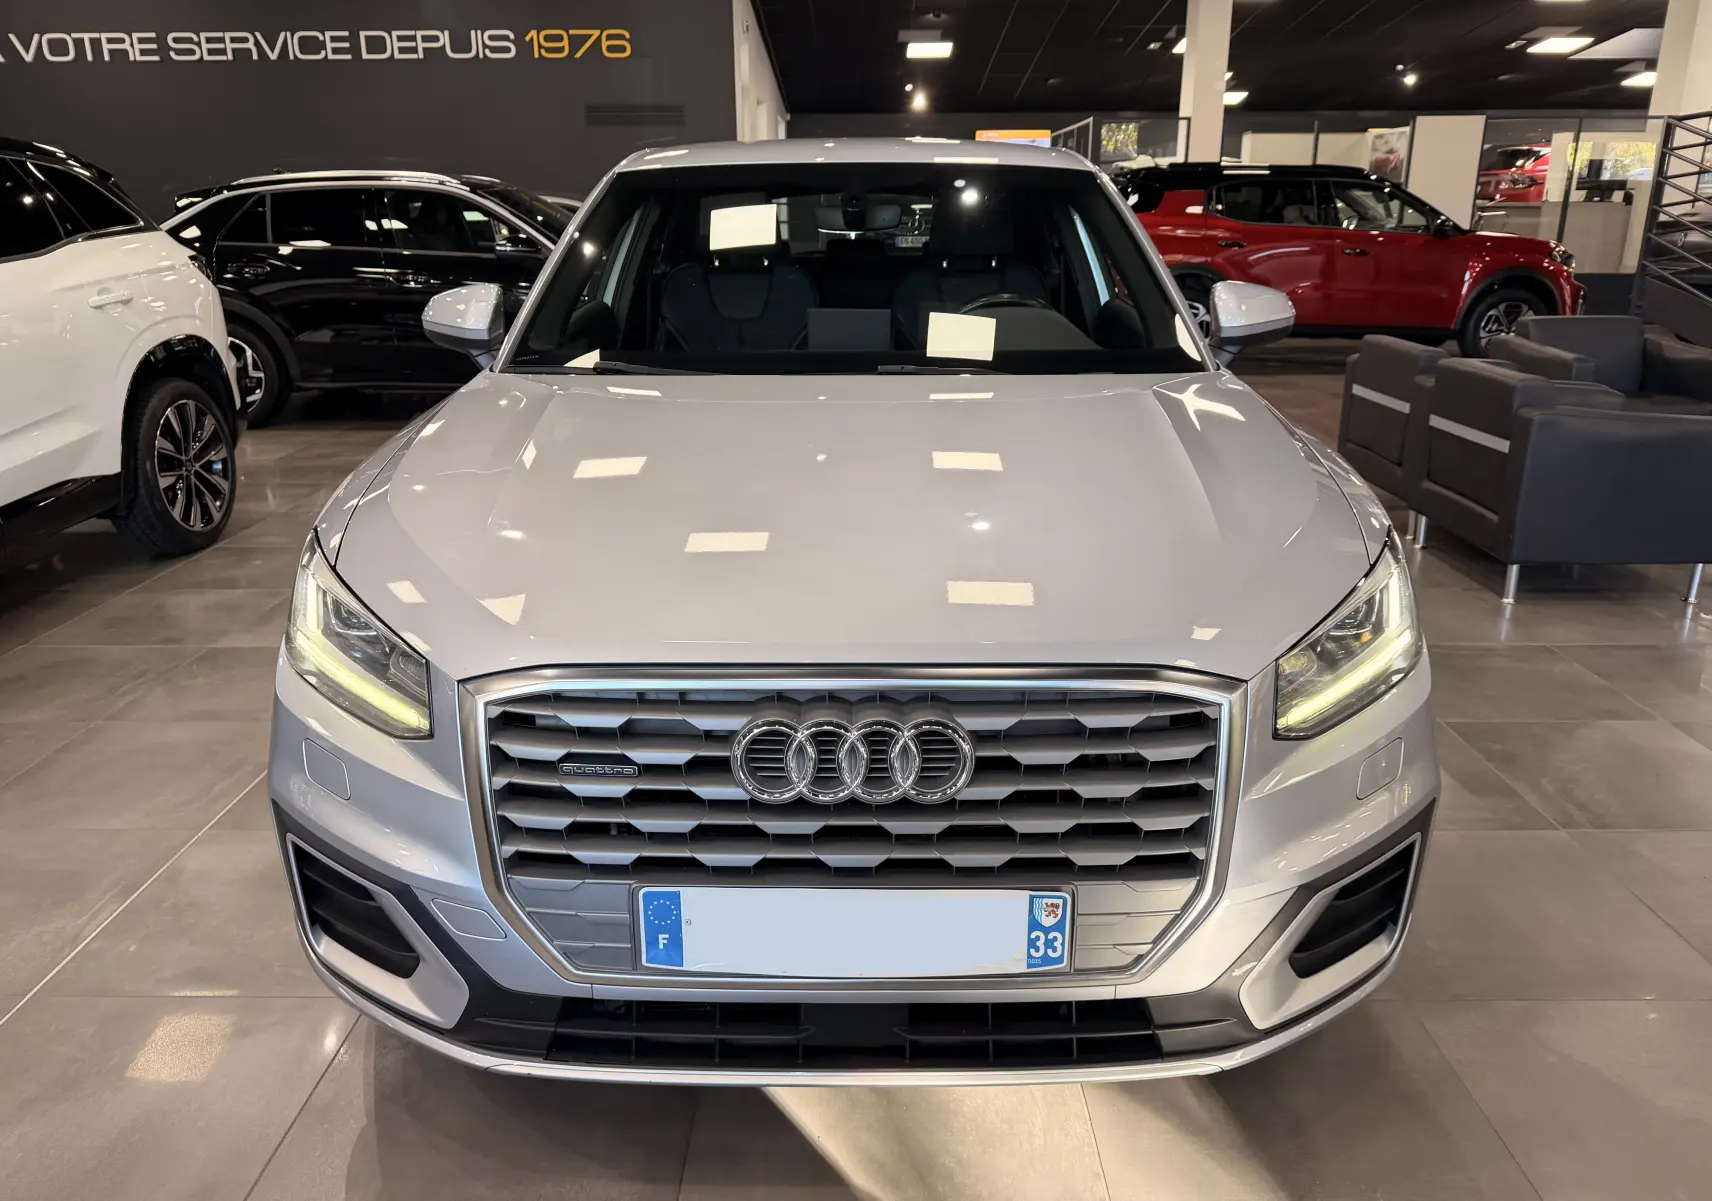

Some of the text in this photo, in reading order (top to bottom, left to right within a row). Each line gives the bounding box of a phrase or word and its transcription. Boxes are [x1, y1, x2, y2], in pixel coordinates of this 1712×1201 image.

[8, 29, 632, 62] VOTRE SERVICE DEPUIS 1976
[562, 766, 634, 775] quattro
[658, 933, 670, 950] F
[1029, 930, 1063, 958] 33
